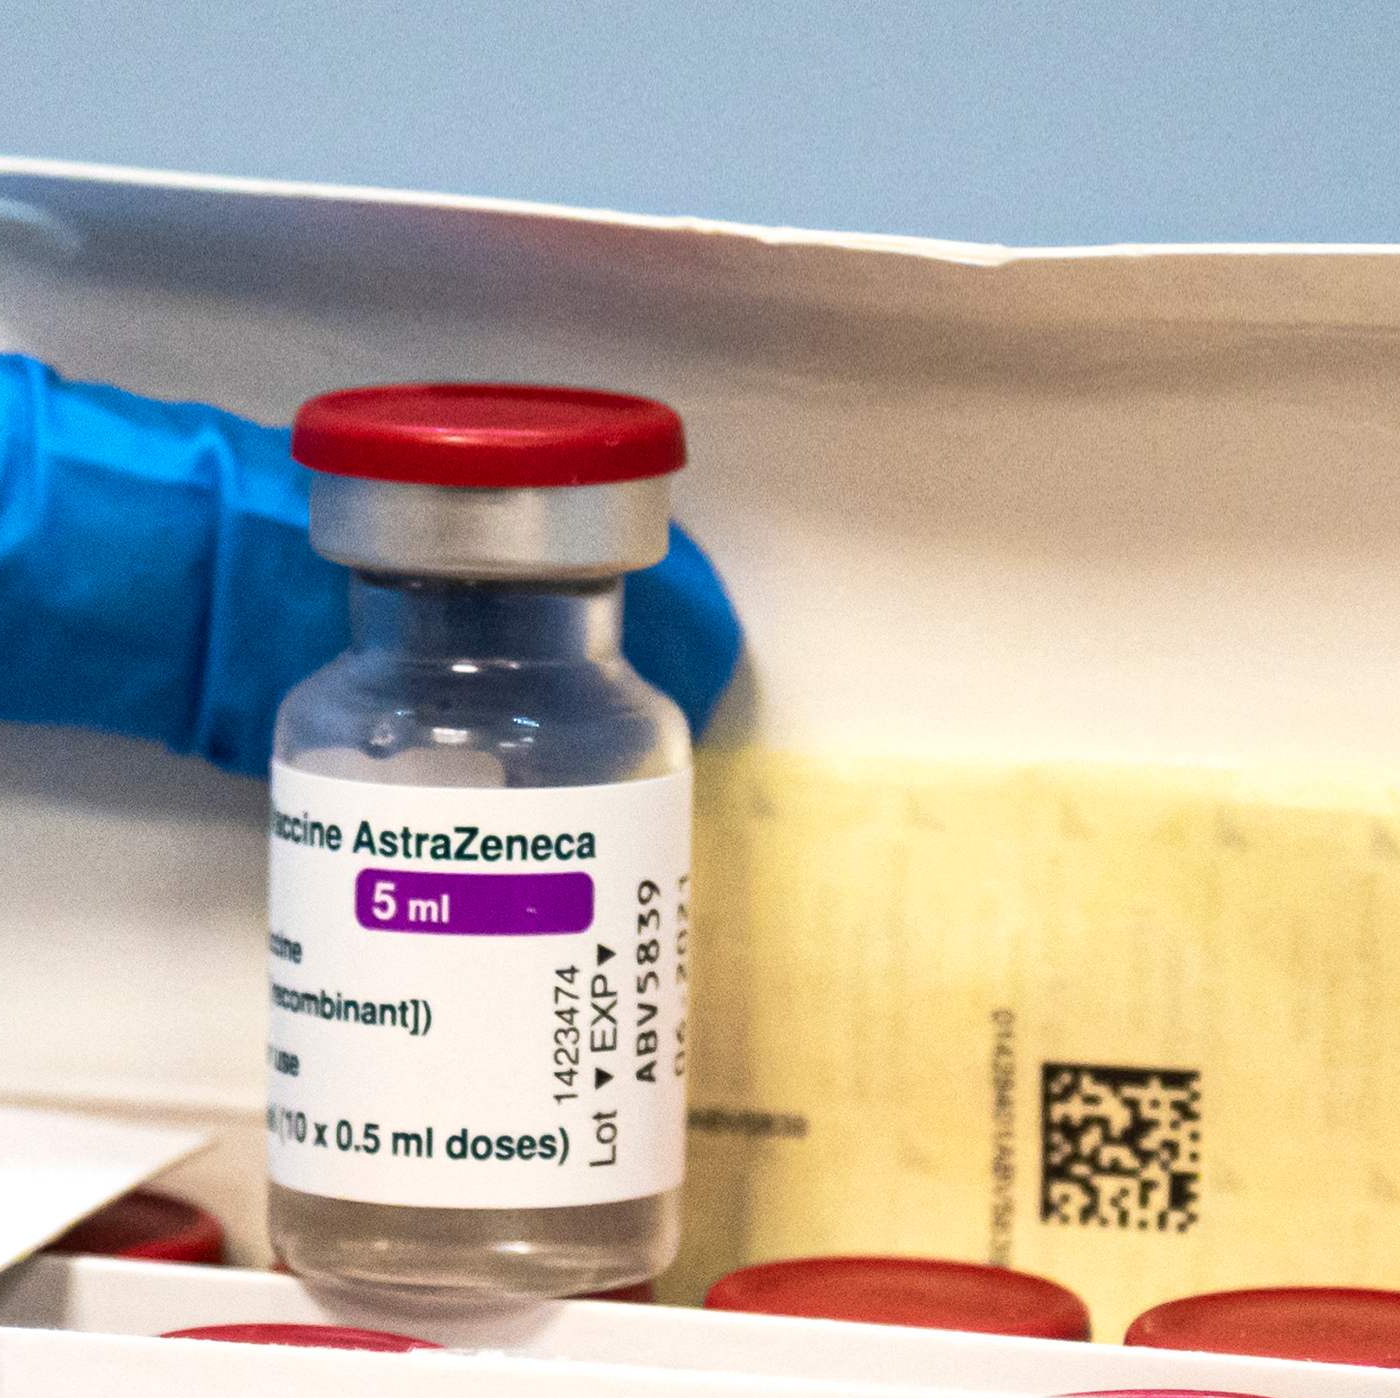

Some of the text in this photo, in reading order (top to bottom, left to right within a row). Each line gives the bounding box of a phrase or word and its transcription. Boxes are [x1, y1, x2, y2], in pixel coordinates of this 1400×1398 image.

[272, 810, 597, 863] accine AstraZeneca
[371, 882, 450, 924] 5 ml
[636, 880, 661, 1083] ABV5839
[553, 964, 581, 1104] 1423474
[589, 972, 618, 1168] Lot EXP
[313, 1121, 328, 1149] x
[335, 1119, 381, 1155] 0.5
[391, 1127, 434, 1158] ml
[446, 1127, 571, 1165] doses)
